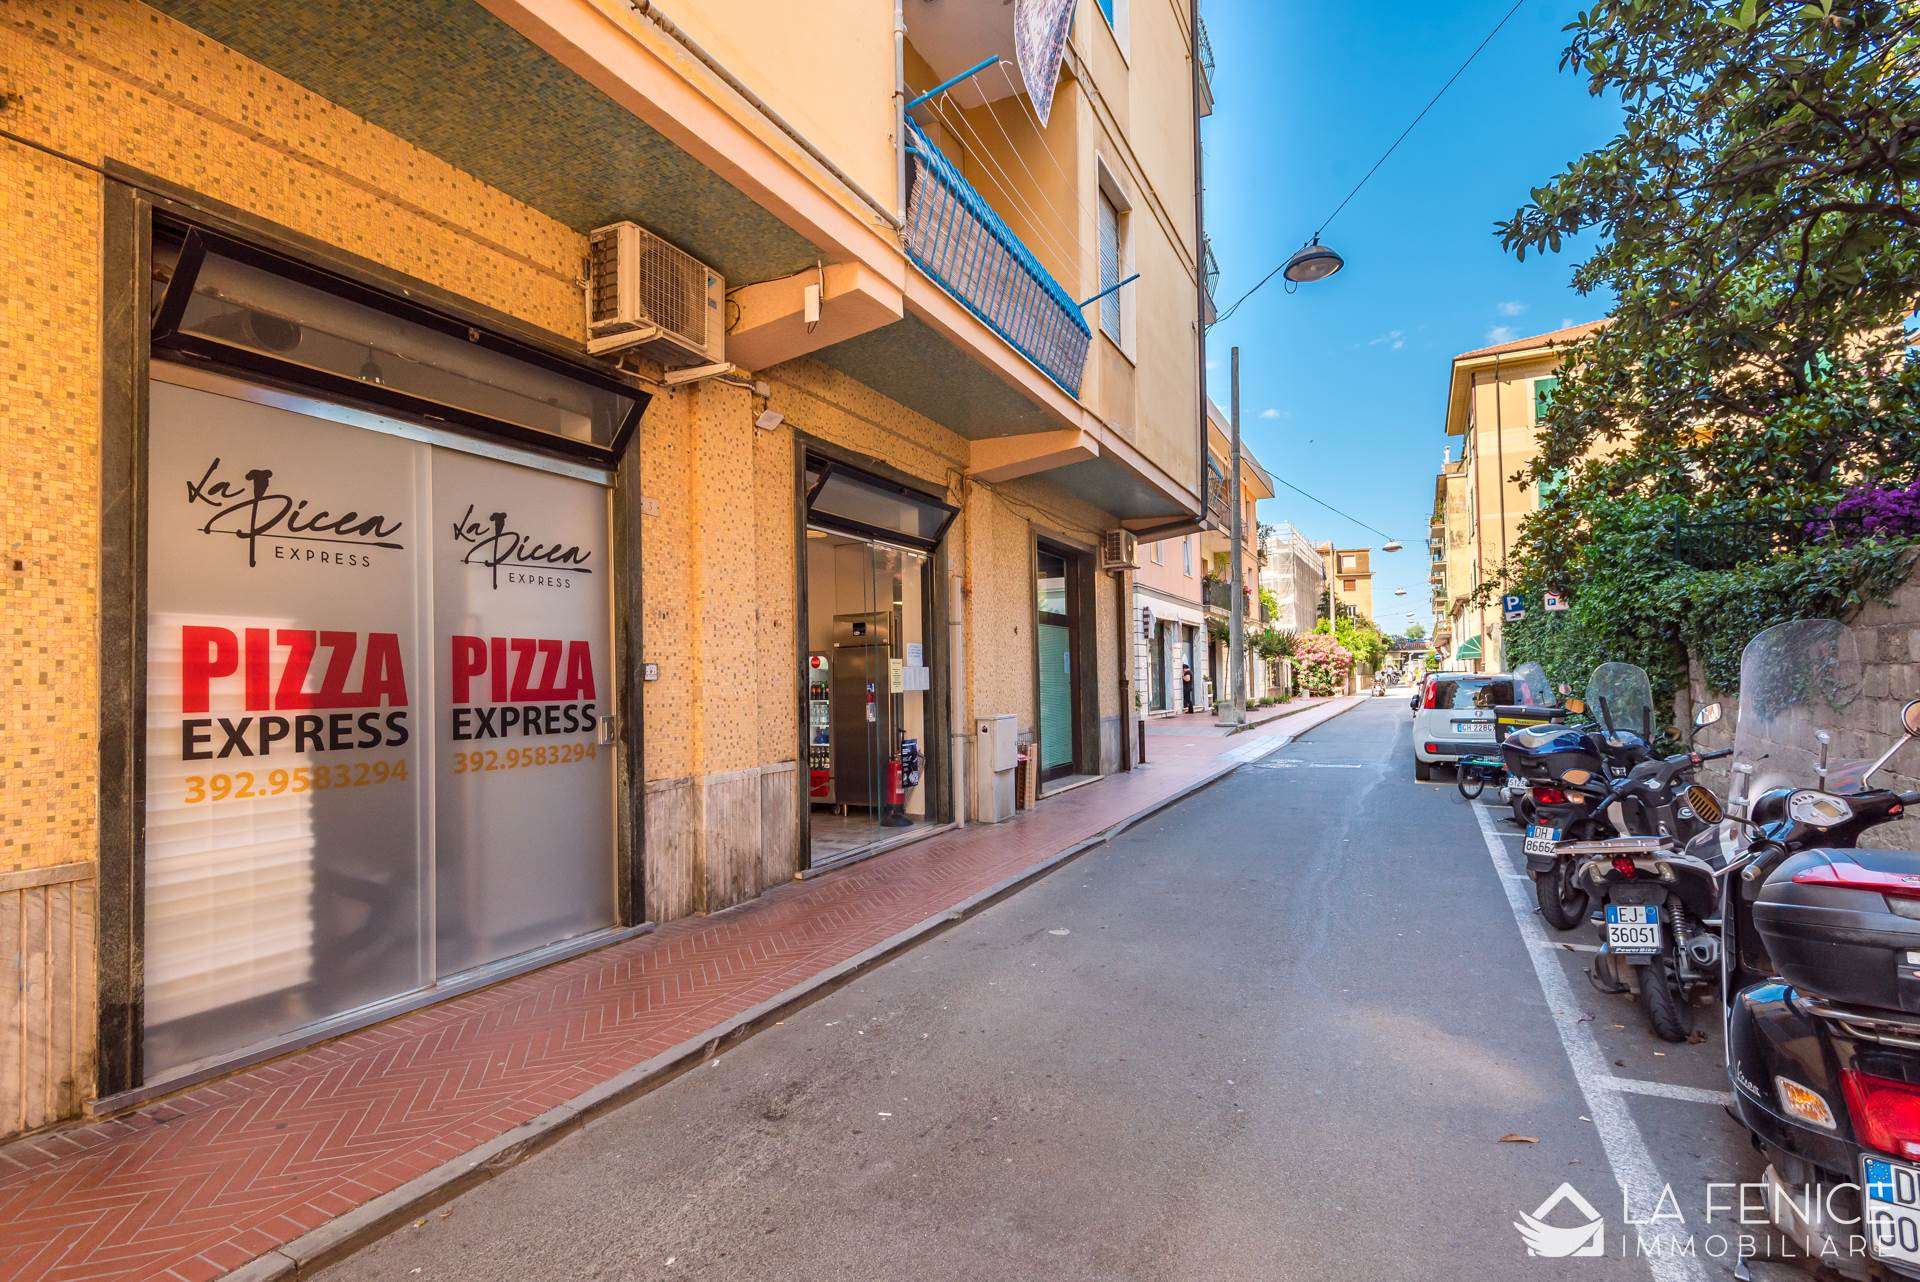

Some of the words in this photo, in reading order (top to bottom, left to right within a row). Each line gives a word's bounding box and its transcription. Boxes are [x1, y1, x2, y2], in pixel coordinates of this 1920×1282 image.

[186, 457, 245, 506] La
[453, 504, 490, 542] La
[275, 546, 371, 568] EXPRESS
[508, 572, 571, 589] EXPRESS
[182, 625, 408, 713] PIZZA
[452, 635, 596, 704] PIZZA
[182, 711, 409, 760] EXPRESS
[452, 703, 597, 741] EXPRESS
[453, 742, 597, 774] 392.9583294
[184, 759, 408, 804] 392.9583294
[1619, 907, 1638, 923] EJ
[1610, 927, 1656, 943] 36051
